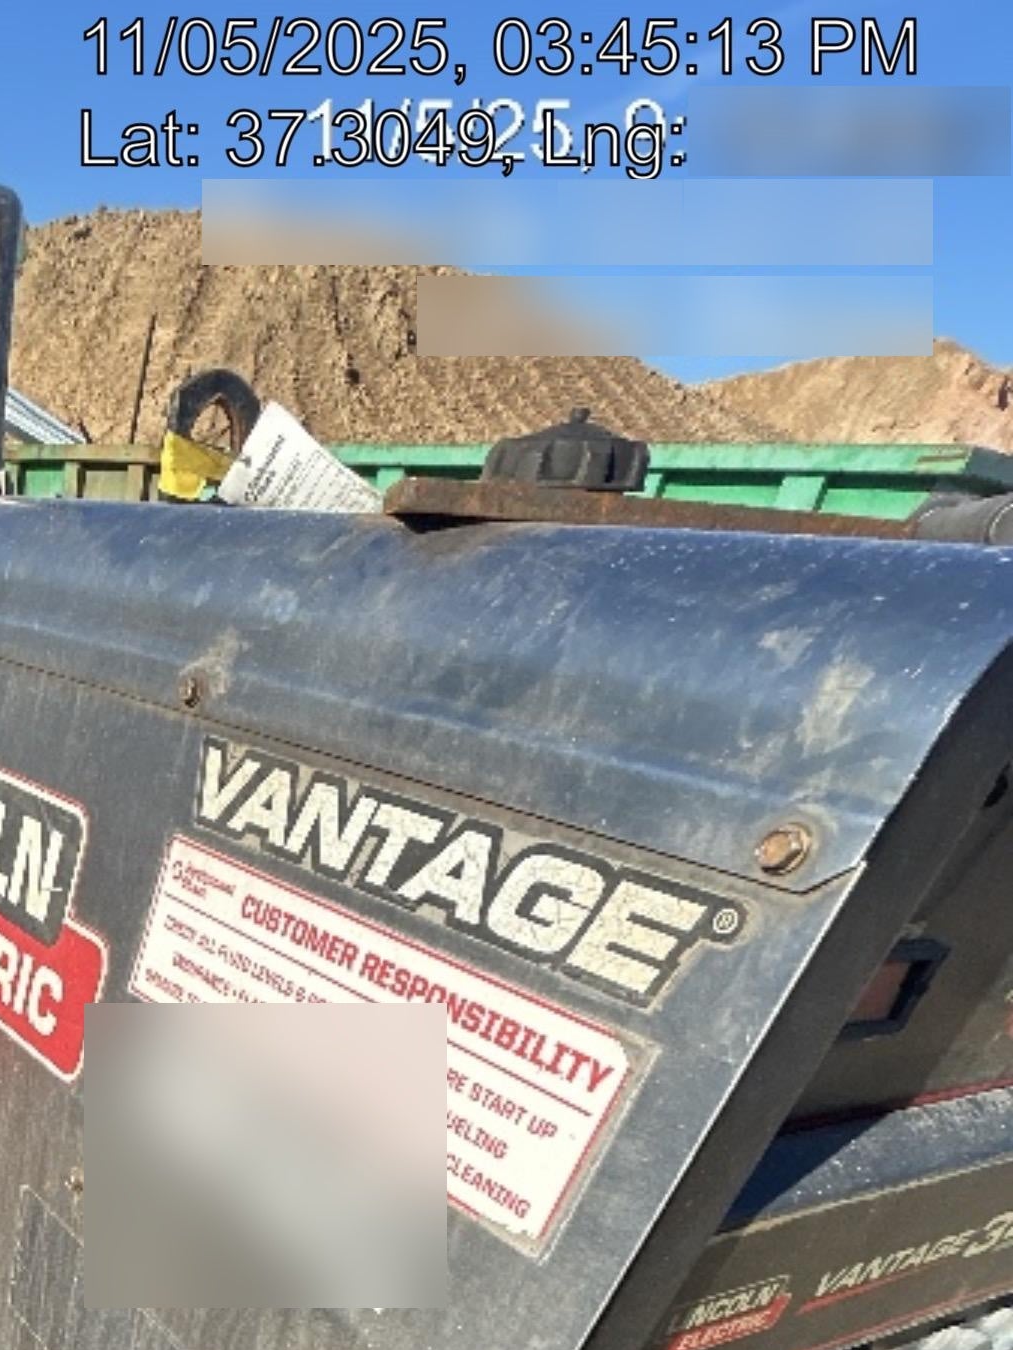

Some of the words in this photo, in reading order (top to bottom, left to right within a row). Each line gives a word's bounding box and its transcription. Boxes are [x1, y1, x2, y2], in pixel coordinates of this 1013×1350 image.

[240, 894, 357, 972] CUSTOMER
[359, 952, 615, 1094] RESPONSIBILITY
[447, 1110, 509, 1160] UELING
[469, 1082, 528, 1125] START
[527, 1115, 558, 1140] UP
